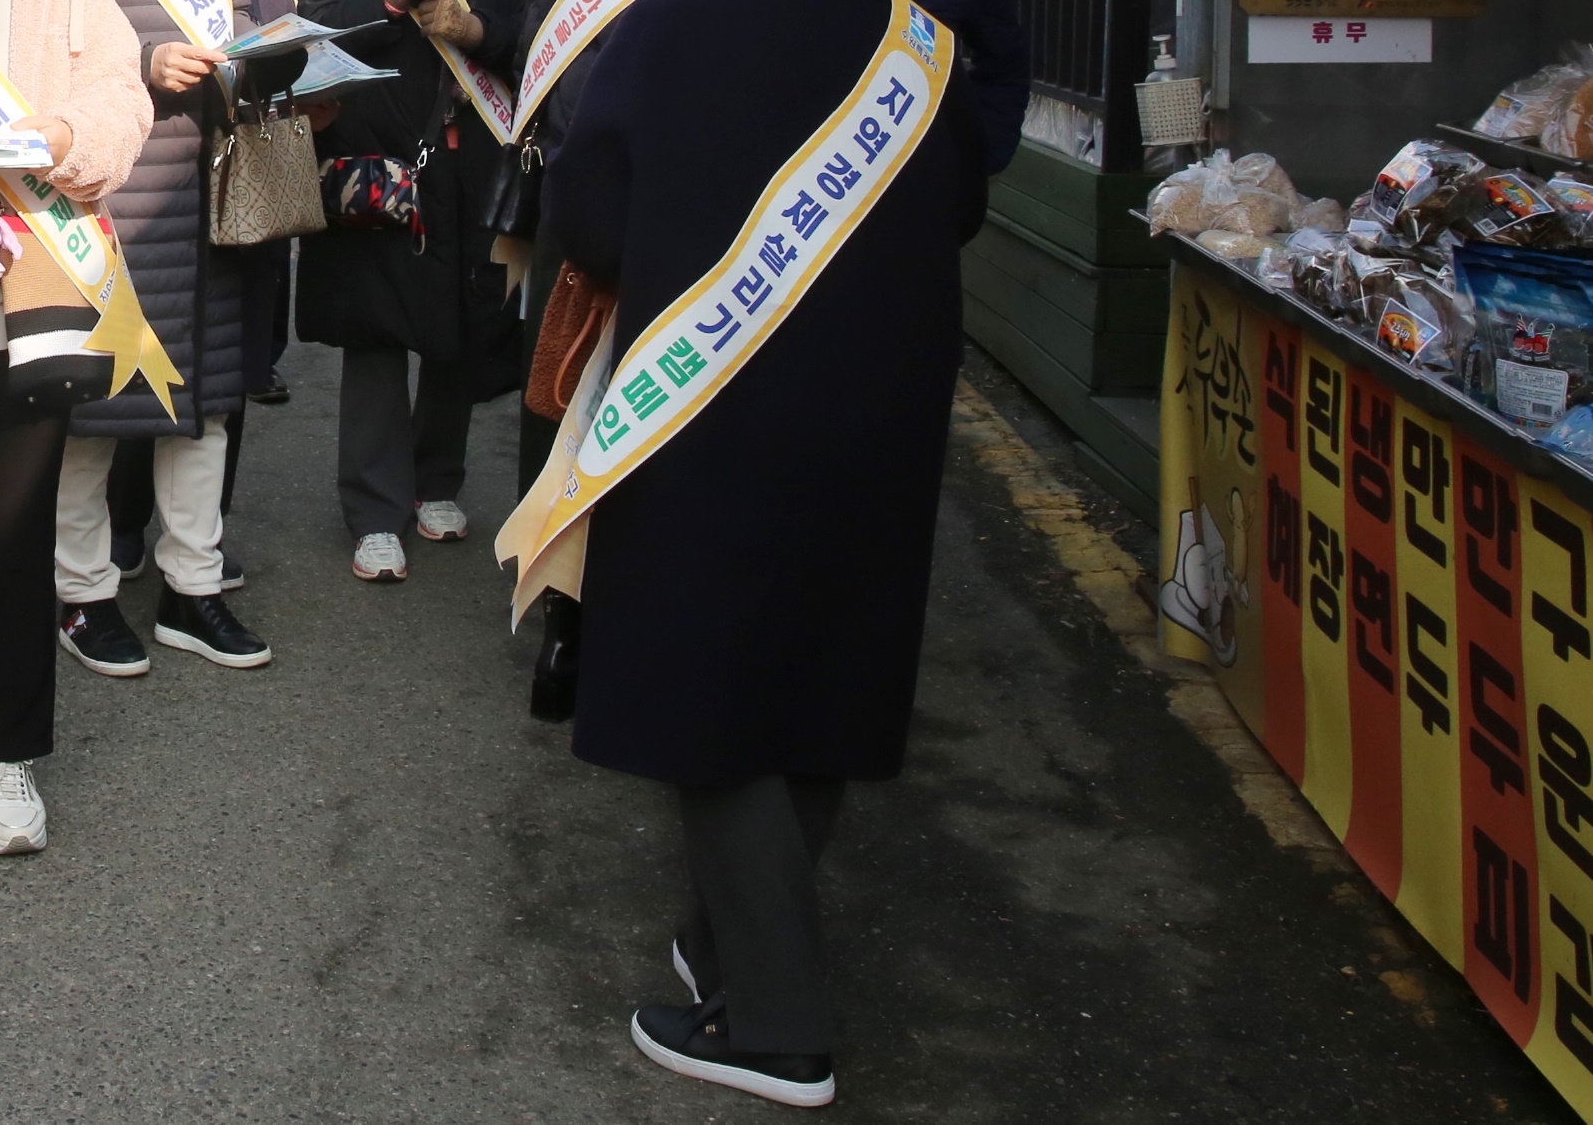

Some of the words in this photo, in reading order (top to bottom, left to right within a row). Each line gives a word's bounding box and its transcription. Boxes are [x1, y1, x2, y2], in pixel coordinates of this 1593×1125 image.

[523, 39, 556, 98] 정확히
[901, 27, 940, 74] 수원특례시
[590, 335, 706, 452] 캠페인
[1264, 329, 1301, 608] 식혜
[1306, 359, 1341, 643] 된장
[1350, 383, 1394, 695] 냉면
[1402, 416, 1451, 737] 만두
[1460, 452, 1530, 1006] 만두피
